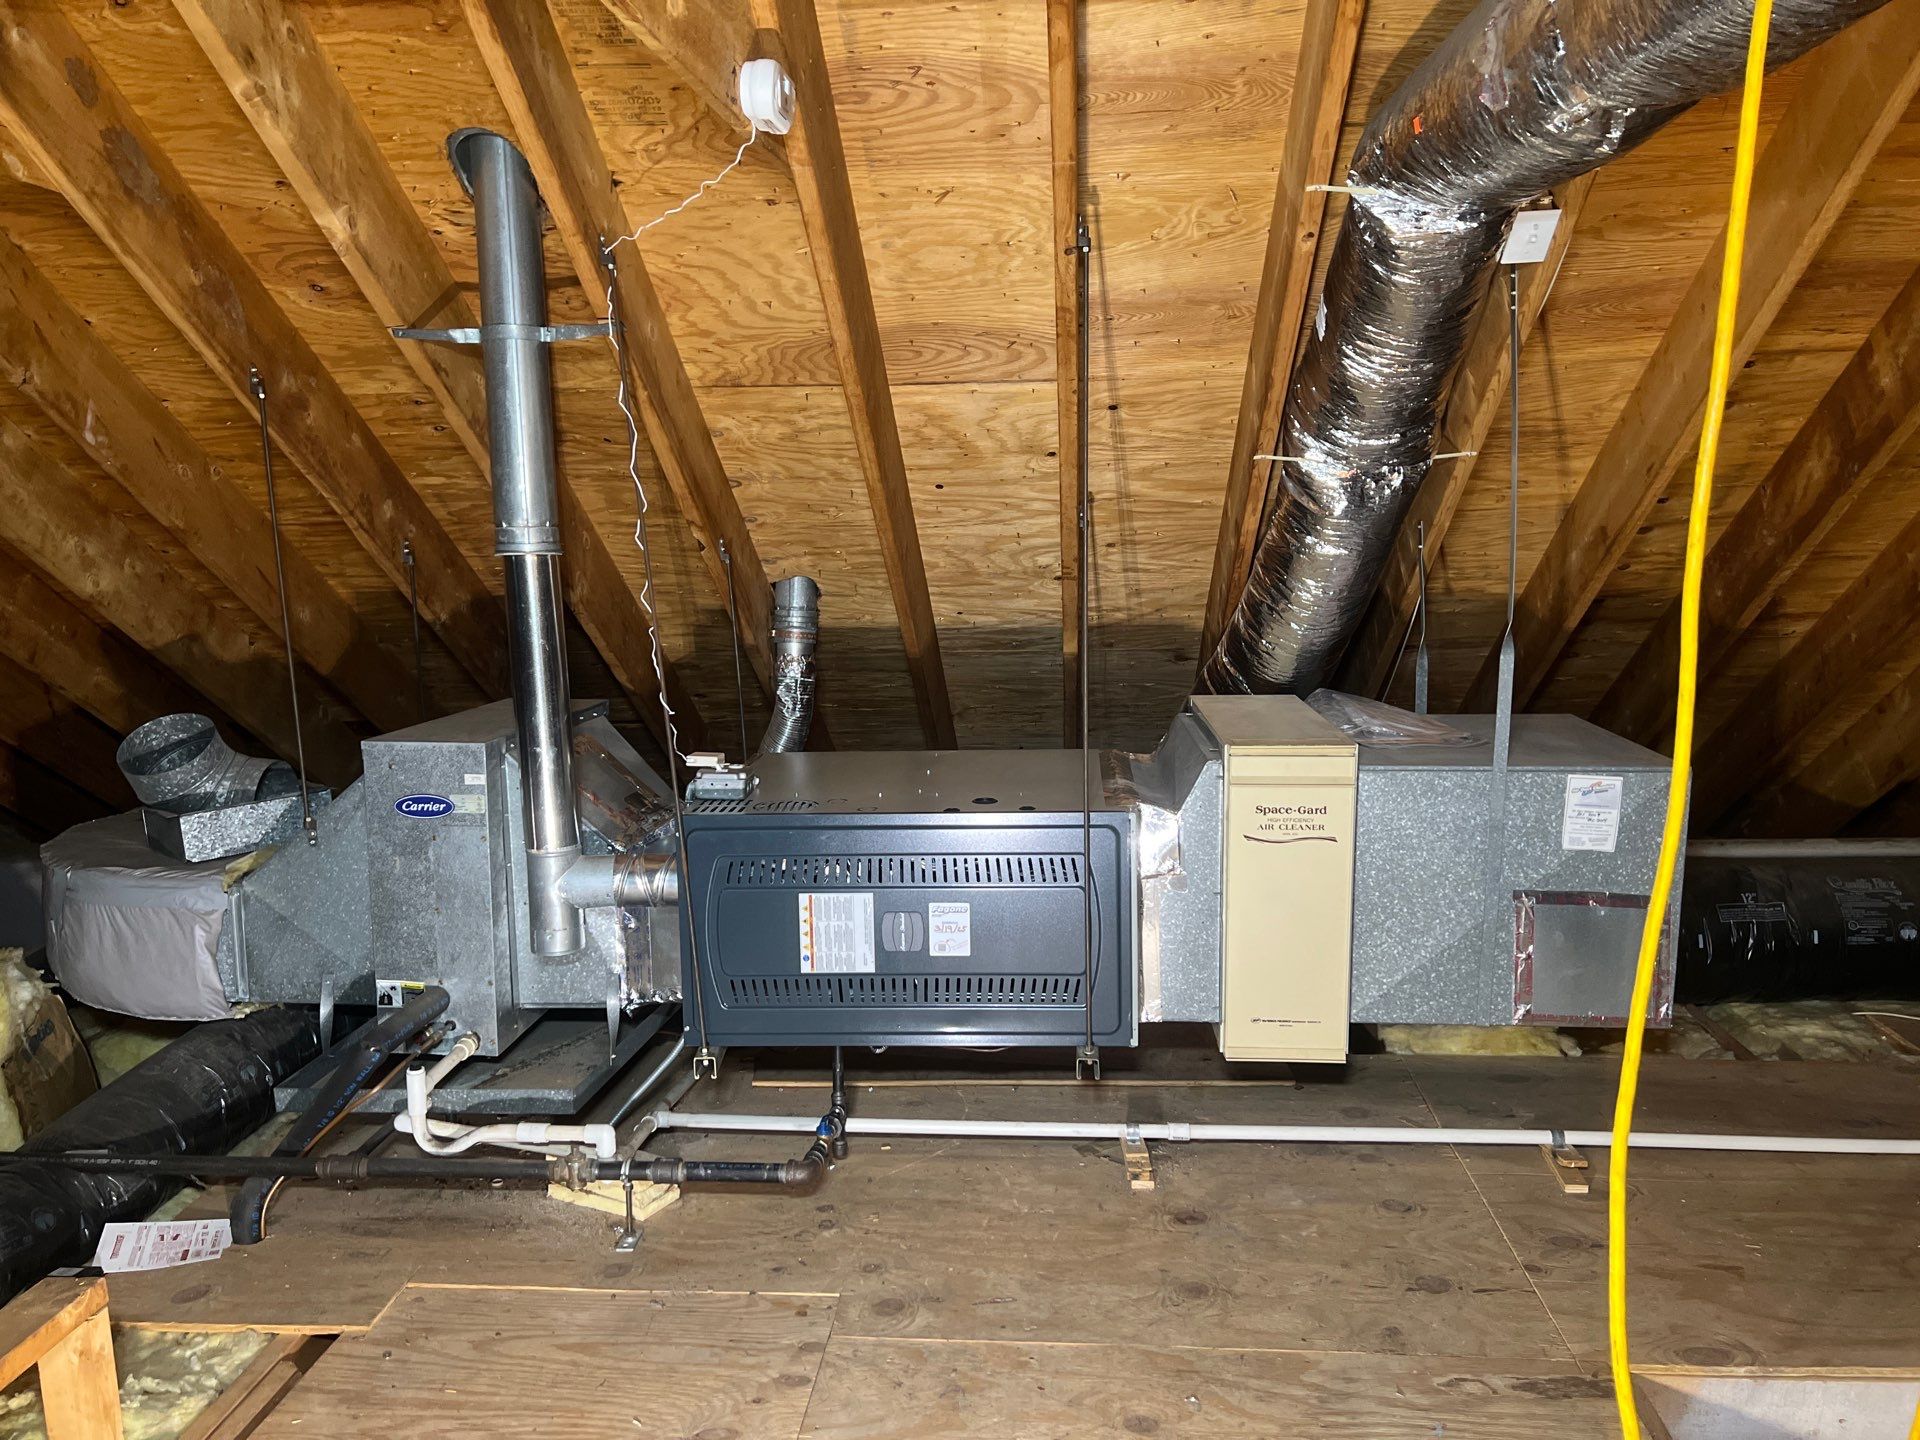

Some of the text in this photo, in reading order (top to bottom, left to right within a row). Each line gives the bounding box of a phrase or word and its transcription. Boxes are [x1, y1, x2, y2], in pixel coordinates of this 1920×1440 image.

[402, 801, 446, 811] Carrier
[1278, 823, 1325, 831] CLEANER
[931, 905, 968, 914] Fagone
